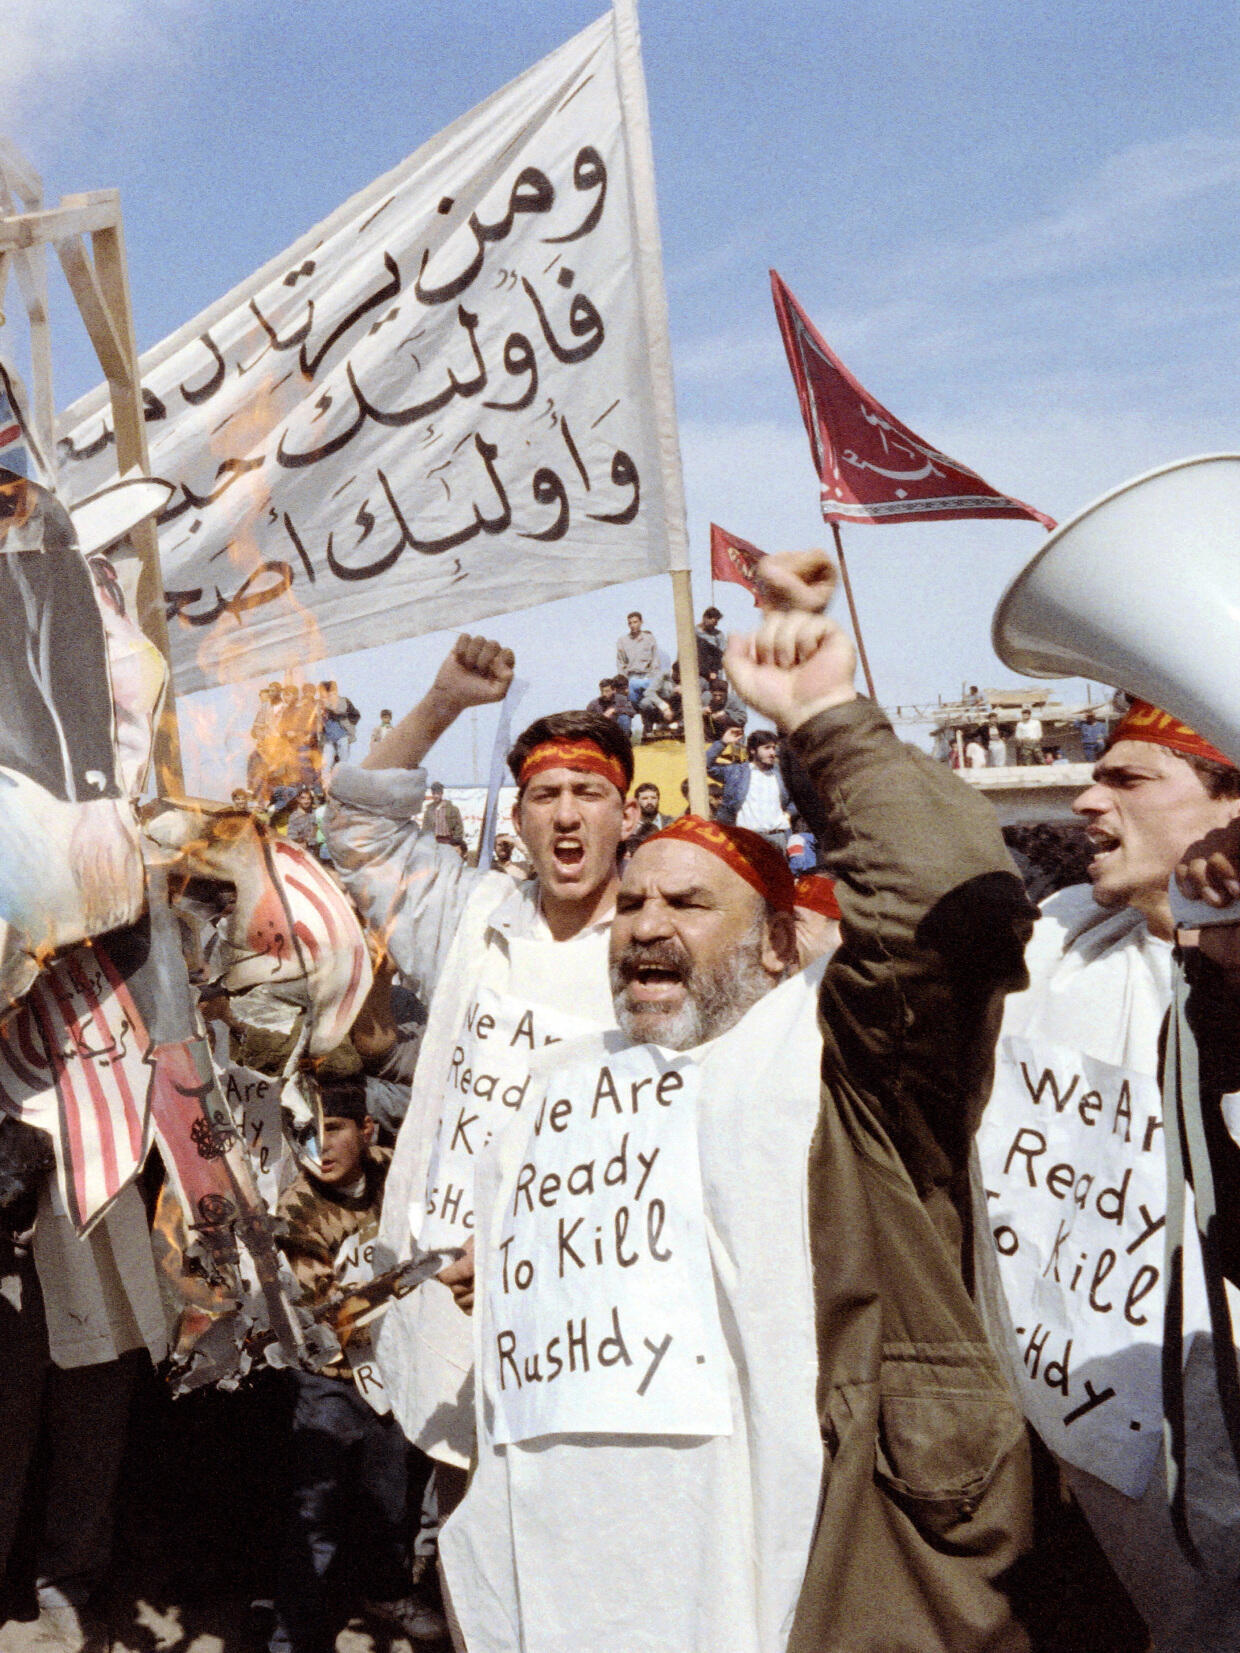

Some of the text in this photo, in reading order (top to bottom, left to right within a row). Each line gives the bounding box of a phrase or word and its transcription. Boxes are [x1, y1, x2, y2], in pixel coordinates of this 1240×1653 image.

[510, 1009, 563, 1050] Ar
[447, 1046, 532, 1112] Read
[591, 1066, 684, 1120] Are
[1020, 1061, 1164, 1152] We Ar
[513, 1132, 661, 1217] Ready
[1003, 1127, 1165, 1254] Ready
[499, 1234, 534, 1294] To
[558, 1198, 673, 1279] Kill
[1042, 1218, 1160, 1327] Kill
